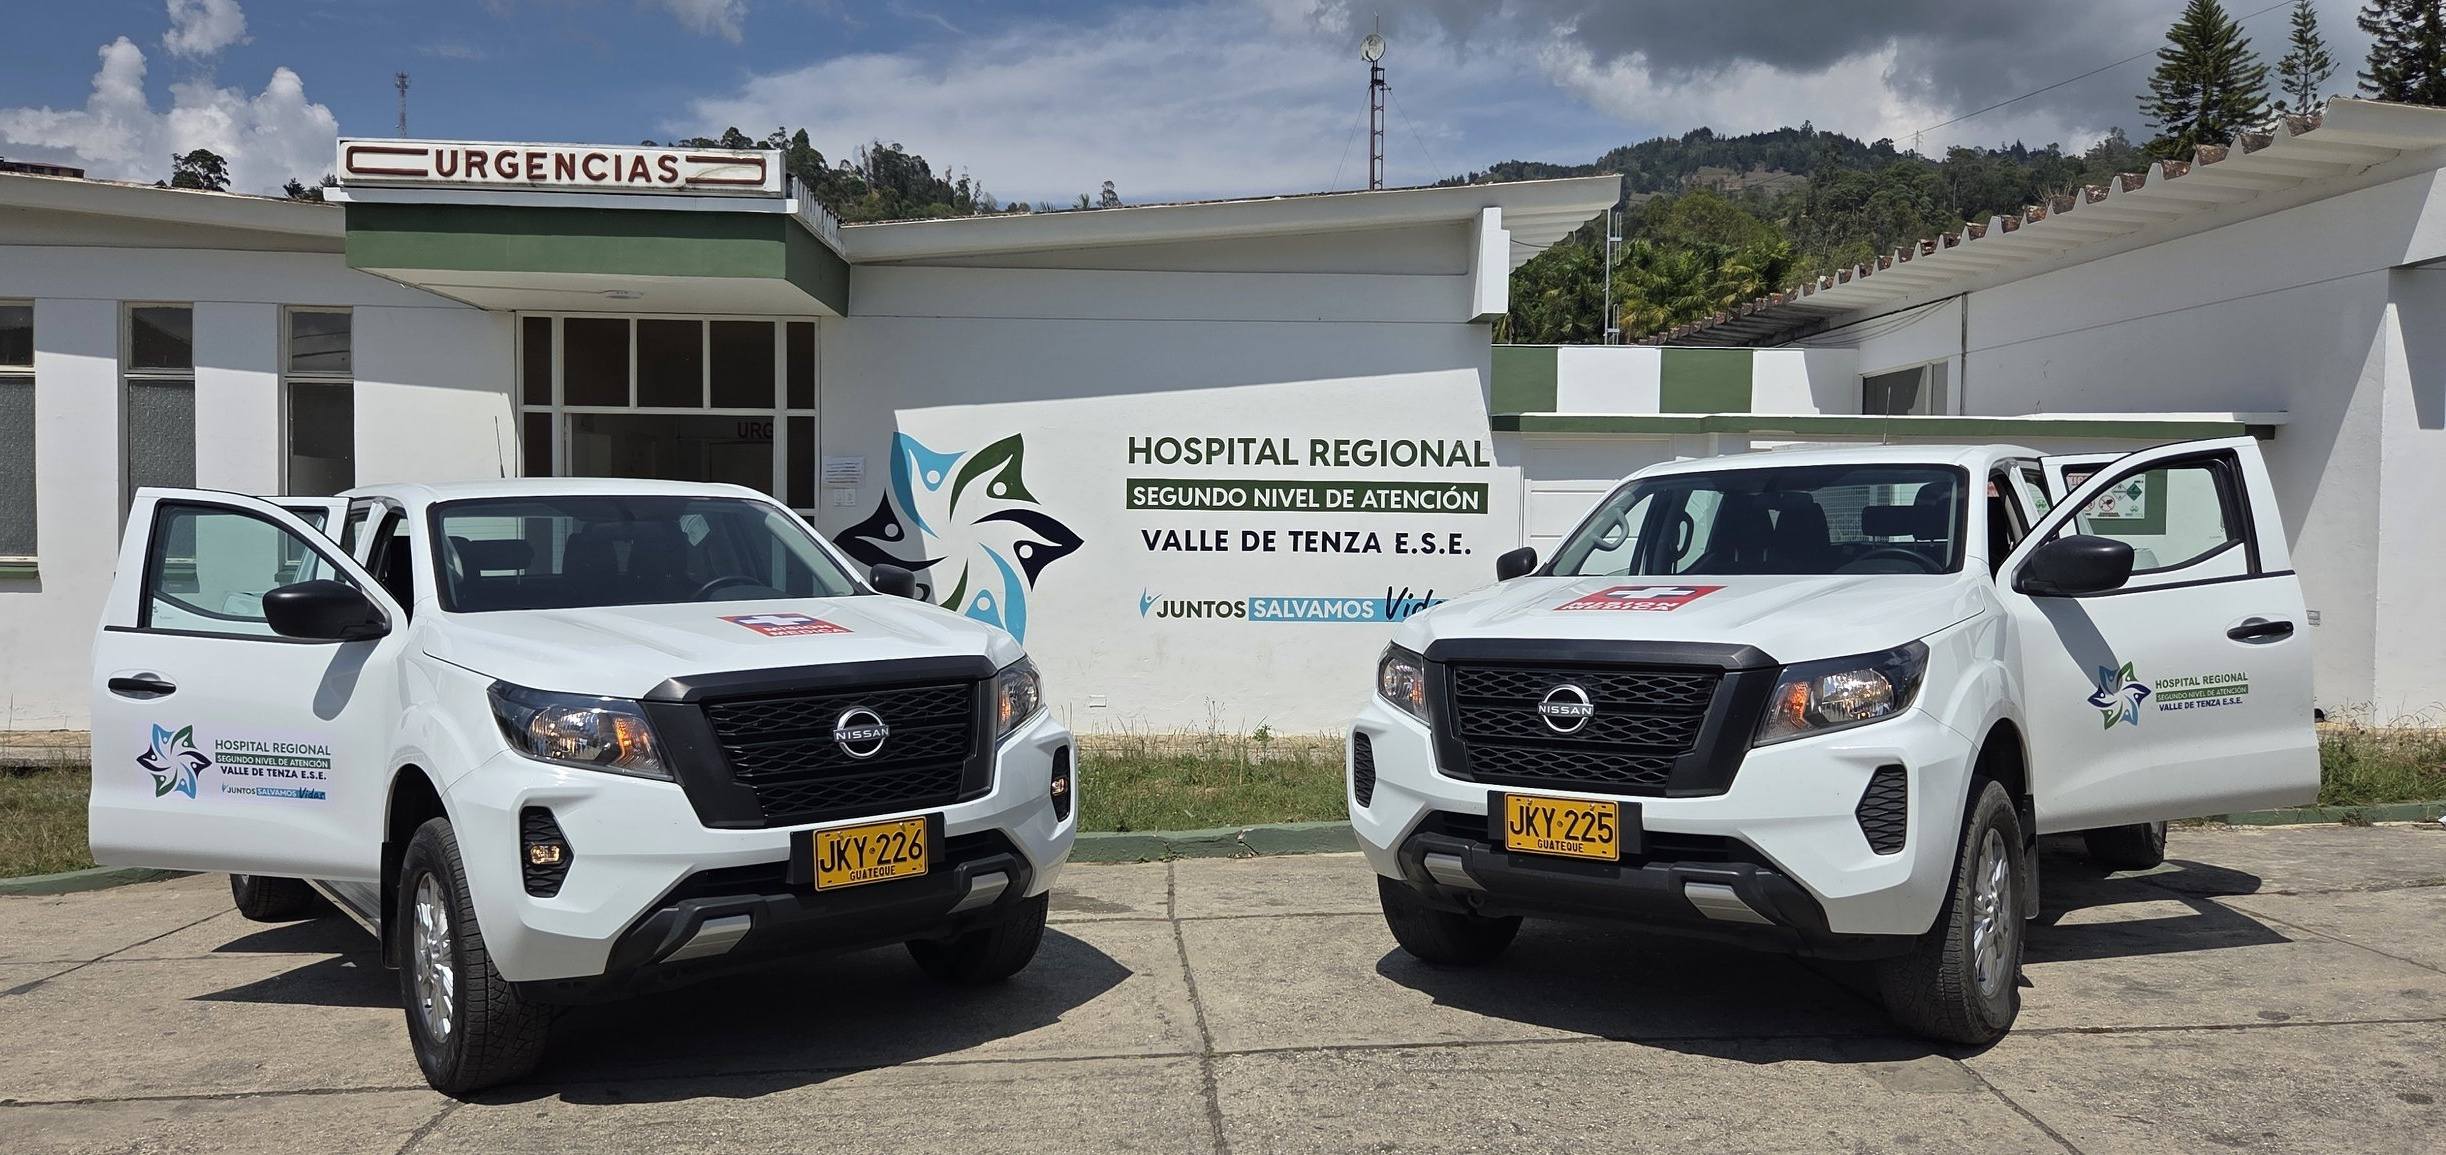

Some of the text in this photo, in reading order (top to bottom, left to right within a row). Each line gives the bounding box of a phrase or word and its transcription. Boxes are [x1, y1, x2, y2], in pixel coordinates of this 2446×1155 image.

[435, 148, 680, 184] URGENCIAS
[1127, 436, 1491, 468] HOSPITAL REGIONAL
[1132, 484, 1479, 510] SEGUNDO NIVEL DE ATENCIÓN
[1141, 529, 1472, 555] VALLE DE TENZA E.S.E.
[1156, 585, 1444, 621] JUNTOS SALVAMOS Vid
[2155, 672, 2249, 689] HOSPITAL REGIONAL
[2157, 692, 2188, 701] SEGUNDO
[2188, 690, 2206, 699] NIVEL
[2206, 689, 2216, 697] DE
[1538, 704, 1592, 715] NISSAN
[2159, 697, 2243, 711] VALLE DE TENZA E.S.E.
[835, 727, 889, 740] NISSAN
[215, 739, 331, 756] HOSPITAL REGIONAL
[217, 755, 329, 768] SEGUNDO NIVEL DE ATENCIÓN
[220, 766, 327, 780] VALLE DE TENZA E.S.E.
[227, 787, 256, 795] JUNTOS
[257, 788, 297, 797] SALVAMOS
[1537, 839, 1584, 853] GUATEQUE
[850, 865, 896, 881] GUATEQUE
